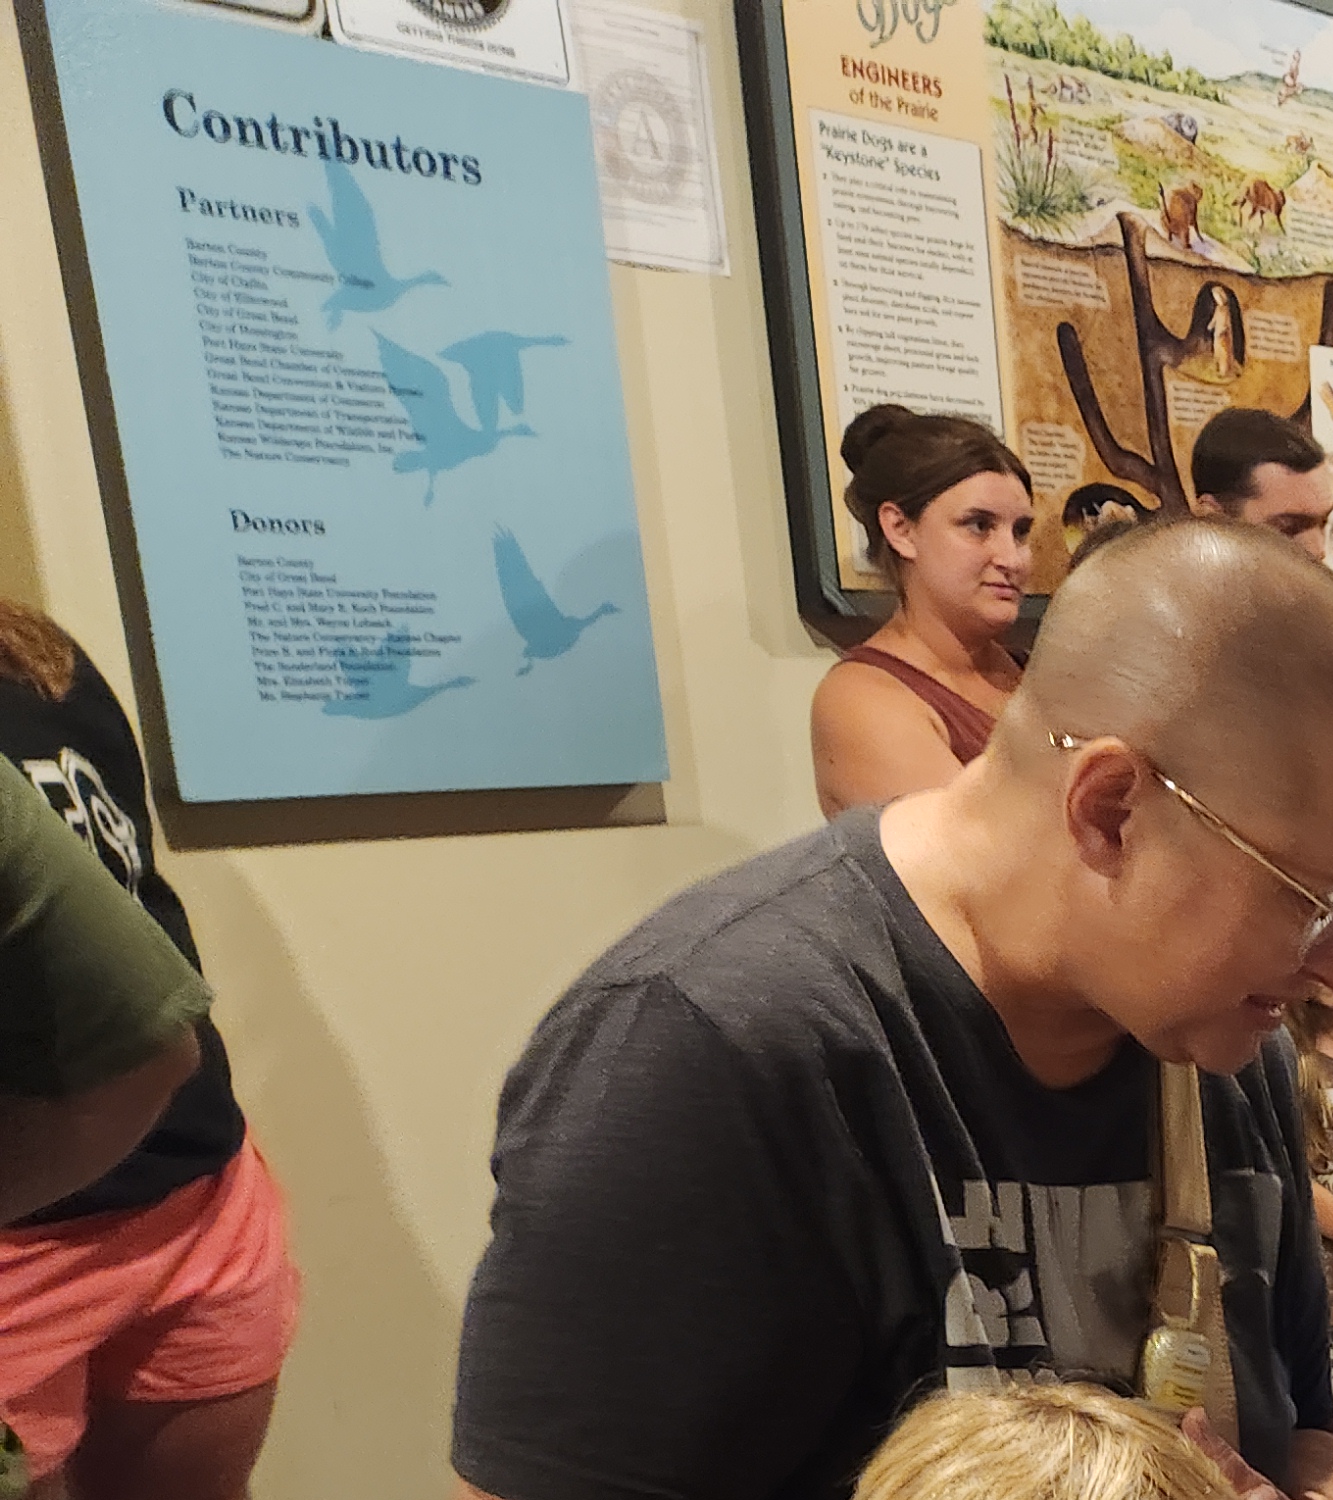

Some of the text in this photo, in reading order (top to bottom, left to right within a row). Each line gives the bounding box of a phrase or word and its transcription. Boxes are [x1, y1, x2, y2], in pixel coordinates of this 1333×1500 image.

[840, 54, 943, 99] ENGINEERS
[849, 87, 939, 122] of the Prairie
[162, 87, 482, 186] Contributors
[818, 120, 858, 141] Prairie
[862, 127, 894, 151] Dogs
[897, 139, 916, 156] are
[893, 158, 941, 182] Species
[175, 185, 300, 228] Partners
[228, 507, 327, 536] Donors
